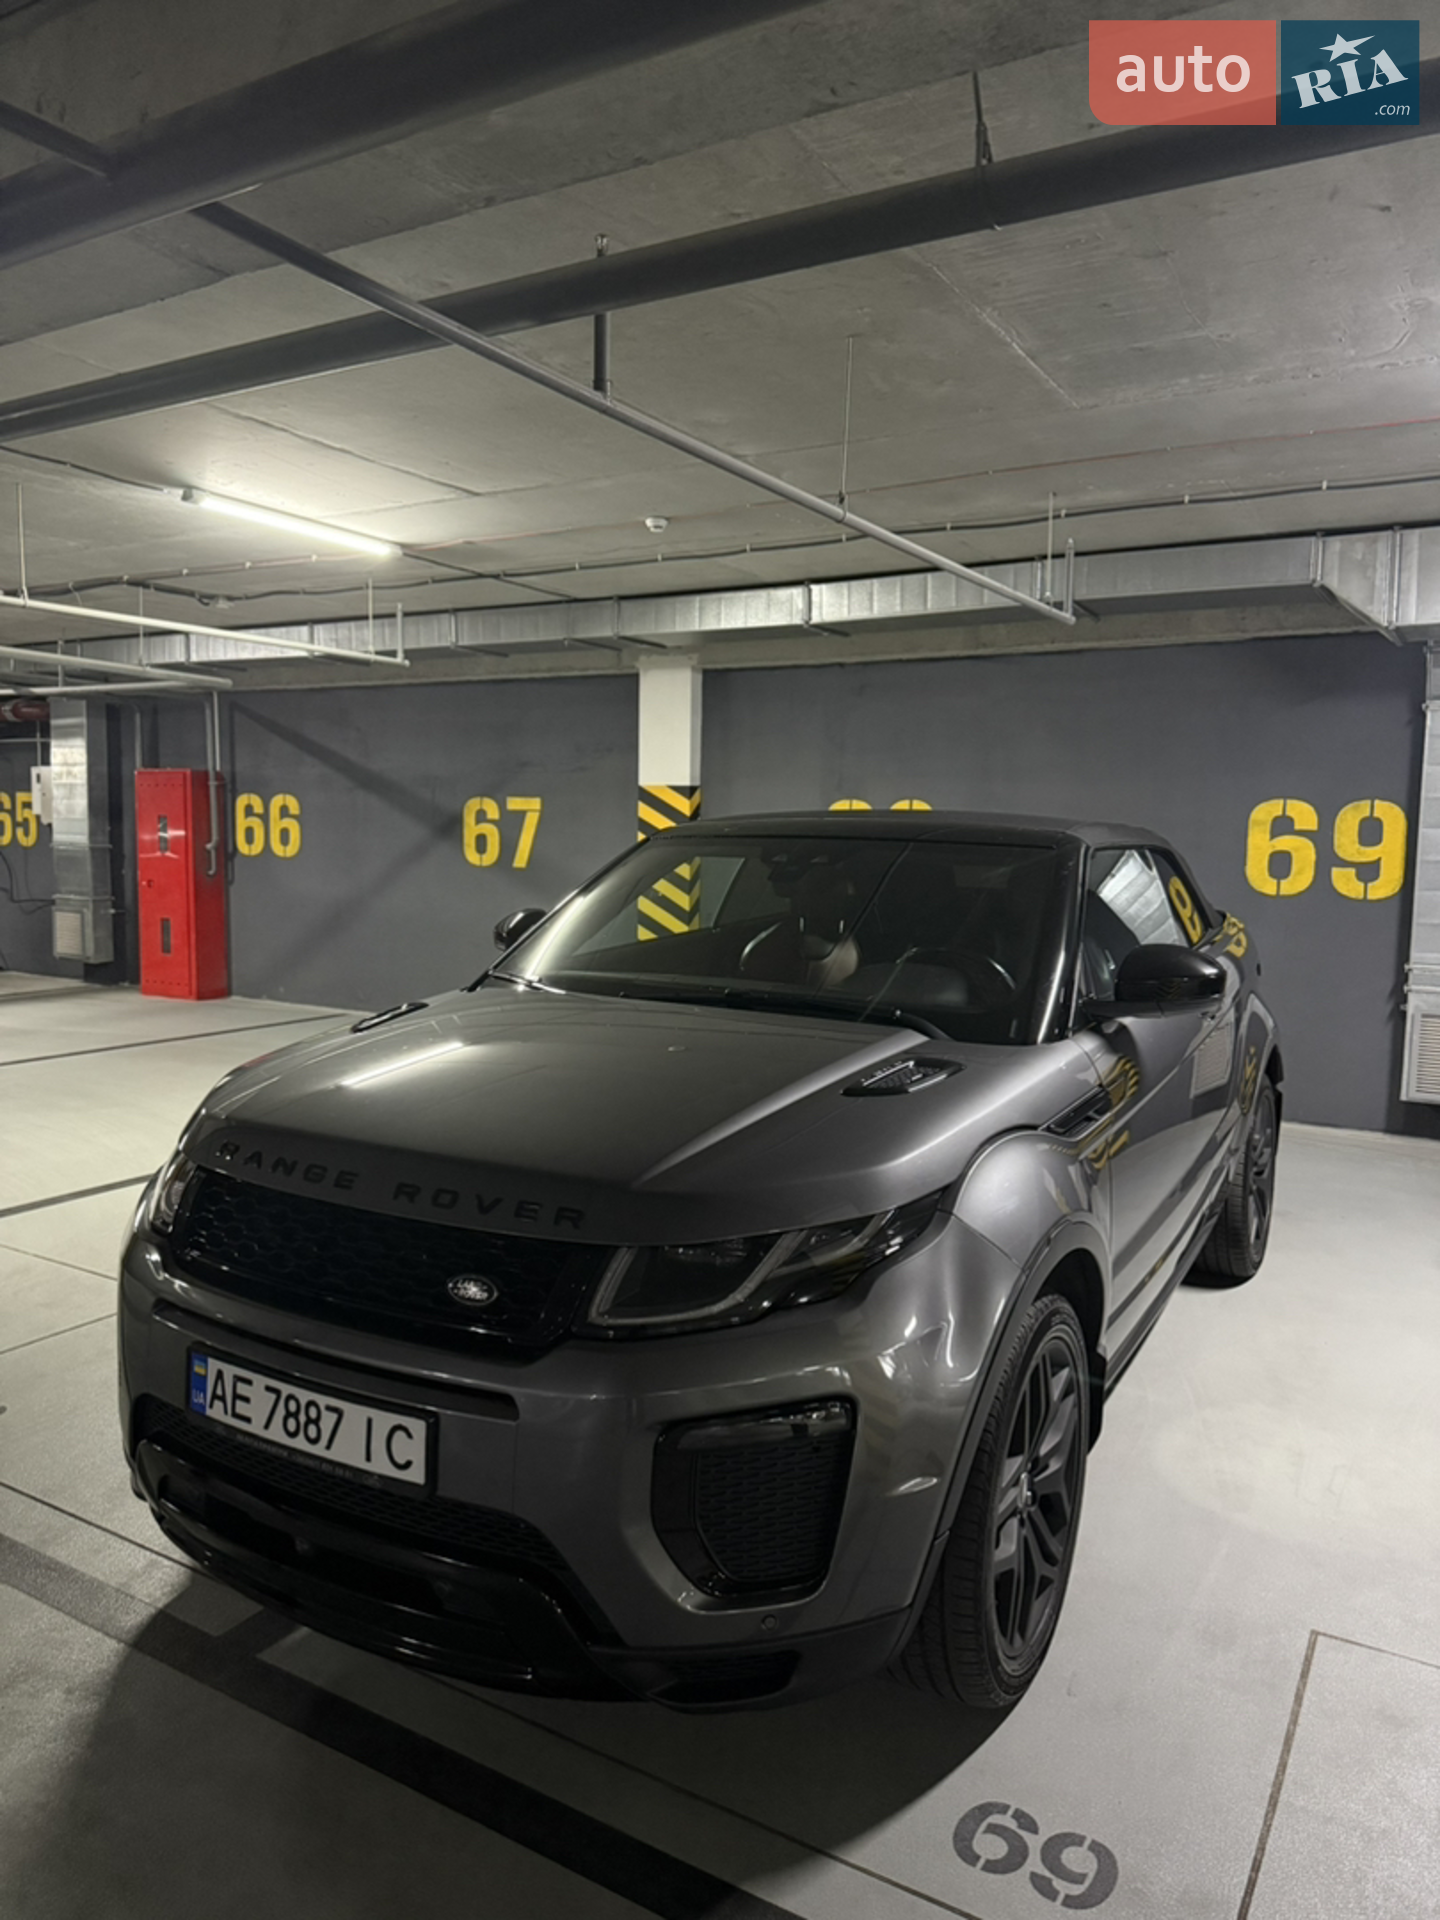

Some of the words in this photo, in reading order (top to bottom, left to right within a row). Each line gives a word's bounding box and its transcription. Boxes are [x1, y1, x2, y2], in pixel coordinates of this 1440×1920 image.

[234, 793, 302, 858] 66
[461, 796, 542, 869] 67
[1244, 798, 1408, 901] 69
[218, 1140, 360, 1190] RANGE
[392, 1182, 586, 1230] ROVER
[208, 1368, 254, 1425] AE
[263, 1384, 345, 1451] 7887
[364, 1416, 414, 1472] IC
[952, 1801, 1119, 1910] 69
